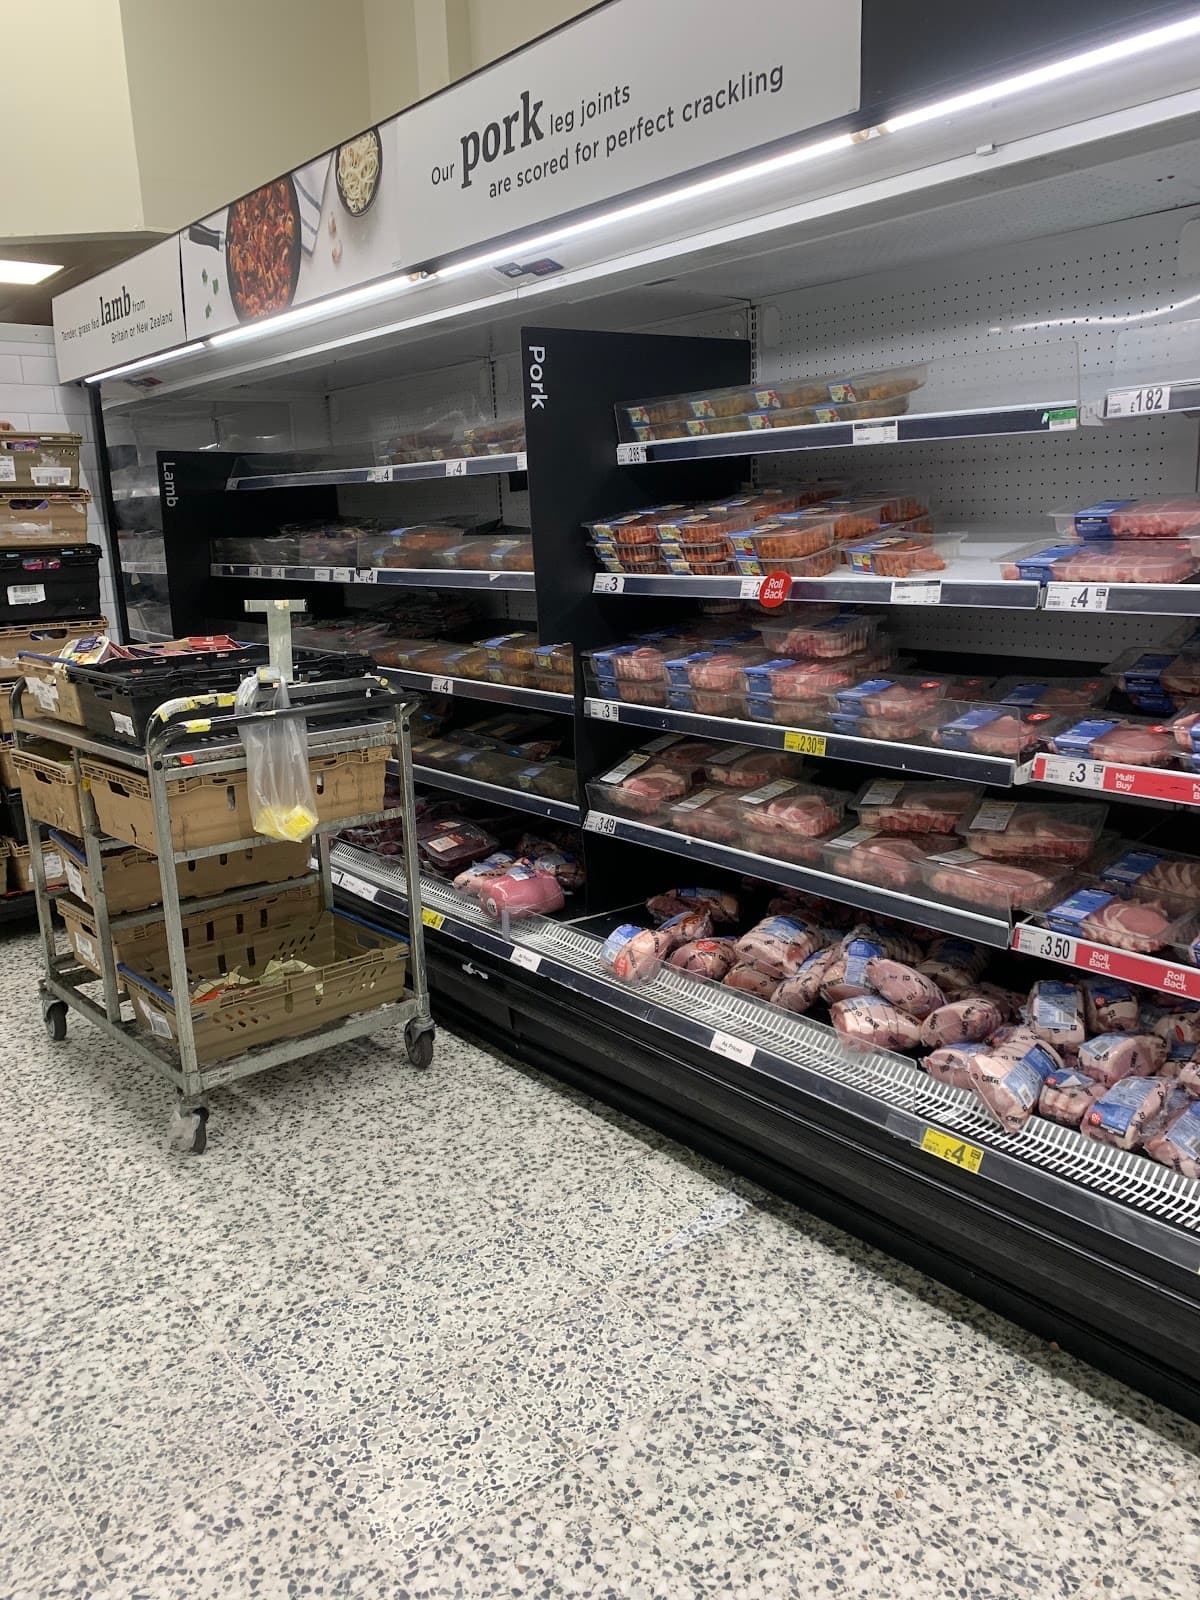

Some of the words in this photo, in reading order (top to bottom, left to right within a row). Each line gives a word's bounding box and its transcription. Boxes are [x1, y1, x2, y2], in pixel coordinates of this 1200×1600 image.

[431, 163, 455, 186] Our
[460, 90, 545, 189] pork
[549, 109, 575, 137] leg
[580, 84, 631, 128] joints
[488, 177, 513, 199] are
[517, 146, 570, 188] scored
[574, 139, 600, 166] for
[605, 106, 675, 159] perfect
[681, 64, 784, 123] crackling
[78, 322, 91, 338] grass
[99, 285, 131, 326] lamb
[132, 299, 146, 313] from
[111, 328, 129, 344] Britain
[129, 327, 136, 337] or
[136, 321, 149, 335] New
[149, 309, 173, 330] Zealand
[528, 345, 548, 410] Pork
[162, 462, 179, 507] Lamb
[604, 576, 618, 591] £3
[768, 578, 784, 589] Roll
[763, 588, 784, 601] Back
[1070, 587, 1089, 608] £4
[439, 680, 449, 693] £4
[1069, 763, 1087, 783] £3
[1115, 772, 1135, 783] Multi
[1115, 780, 1132, 791] Buy
[1040, 935, 1070, 959] £3.50
[1089, 958, 1111, 970] Back
[1092, 951, 1109, 962] Roll
[1163, 977, 1187, 991] Back
[1167, 970, 1186, 982] Roll
[944, 1144, 967, 1164] £4
